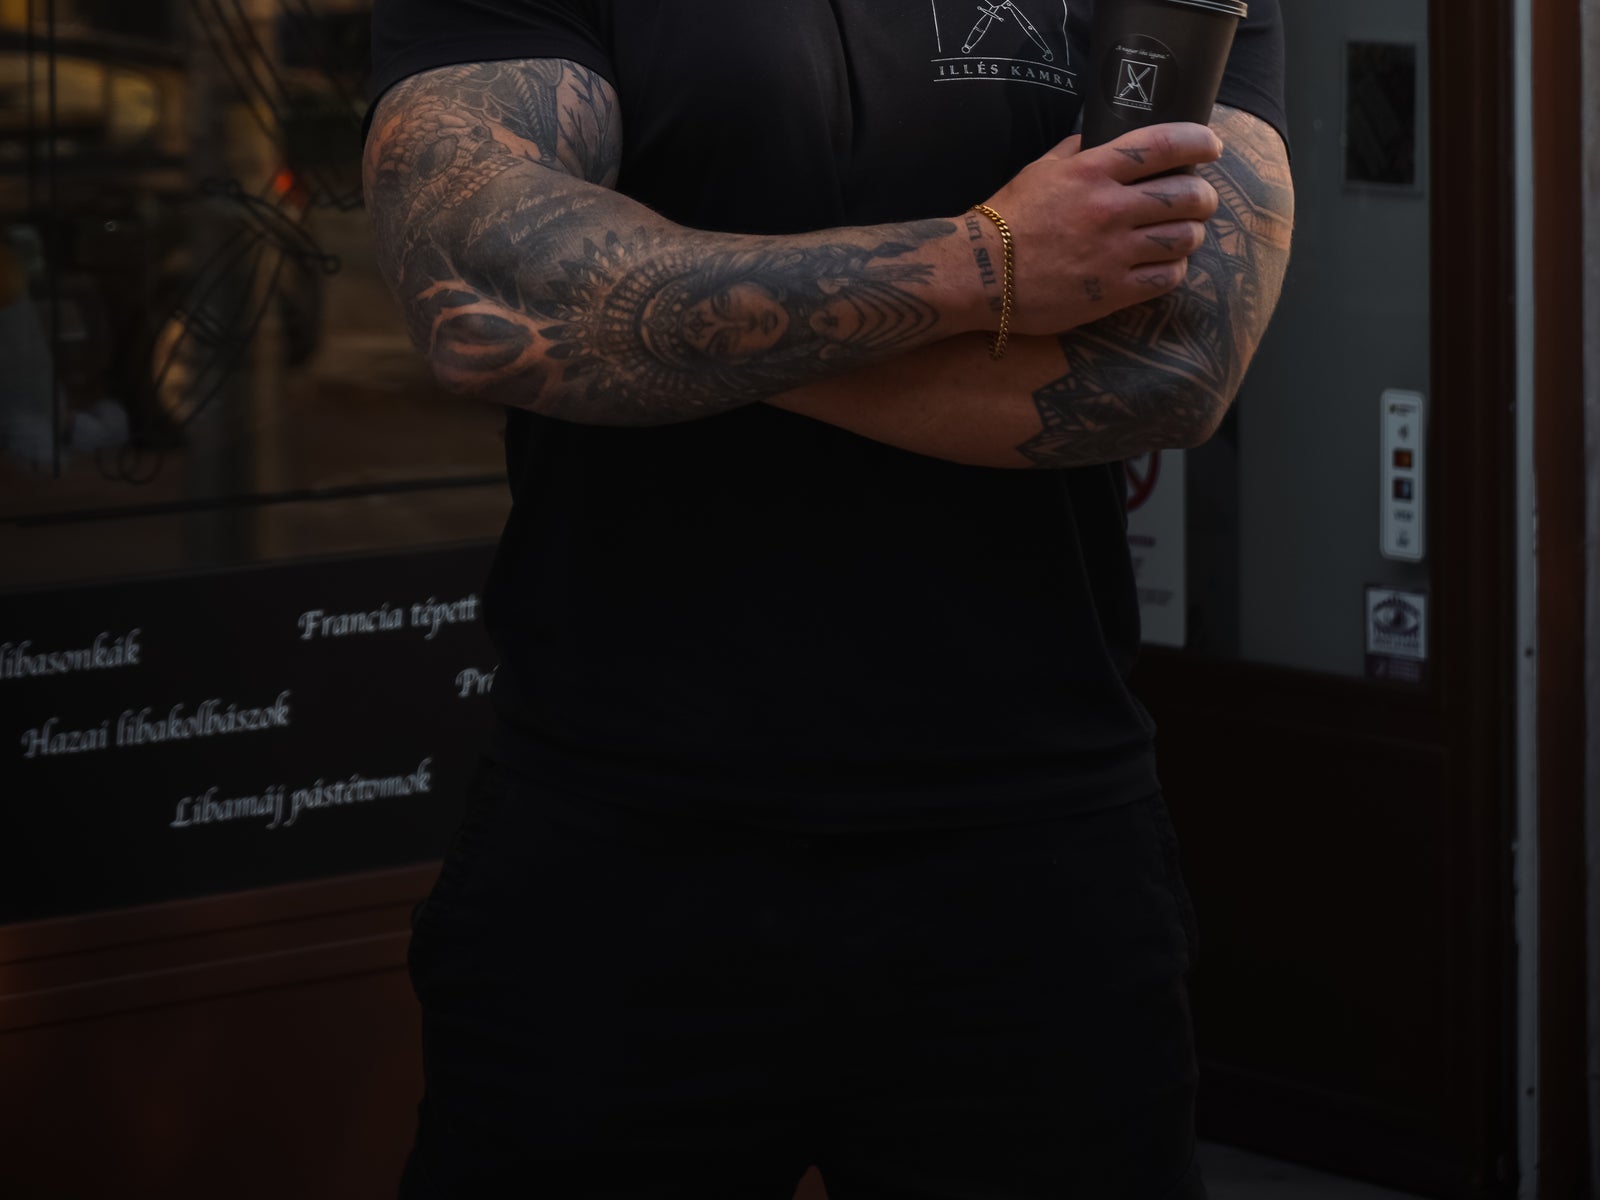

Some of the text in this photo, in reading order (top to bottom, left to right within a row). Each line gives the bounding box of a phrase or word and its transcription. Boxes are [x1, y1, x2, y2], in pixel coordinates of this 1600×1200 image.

[938, 61, 1075, 89] ILLÉS KAMRA
[297, 593, 481, 641] Francia tépett
[20, 689, 292, 759] Hazai libakolbászok
[169, 757, 433, 831] Libamáj pástétomok
